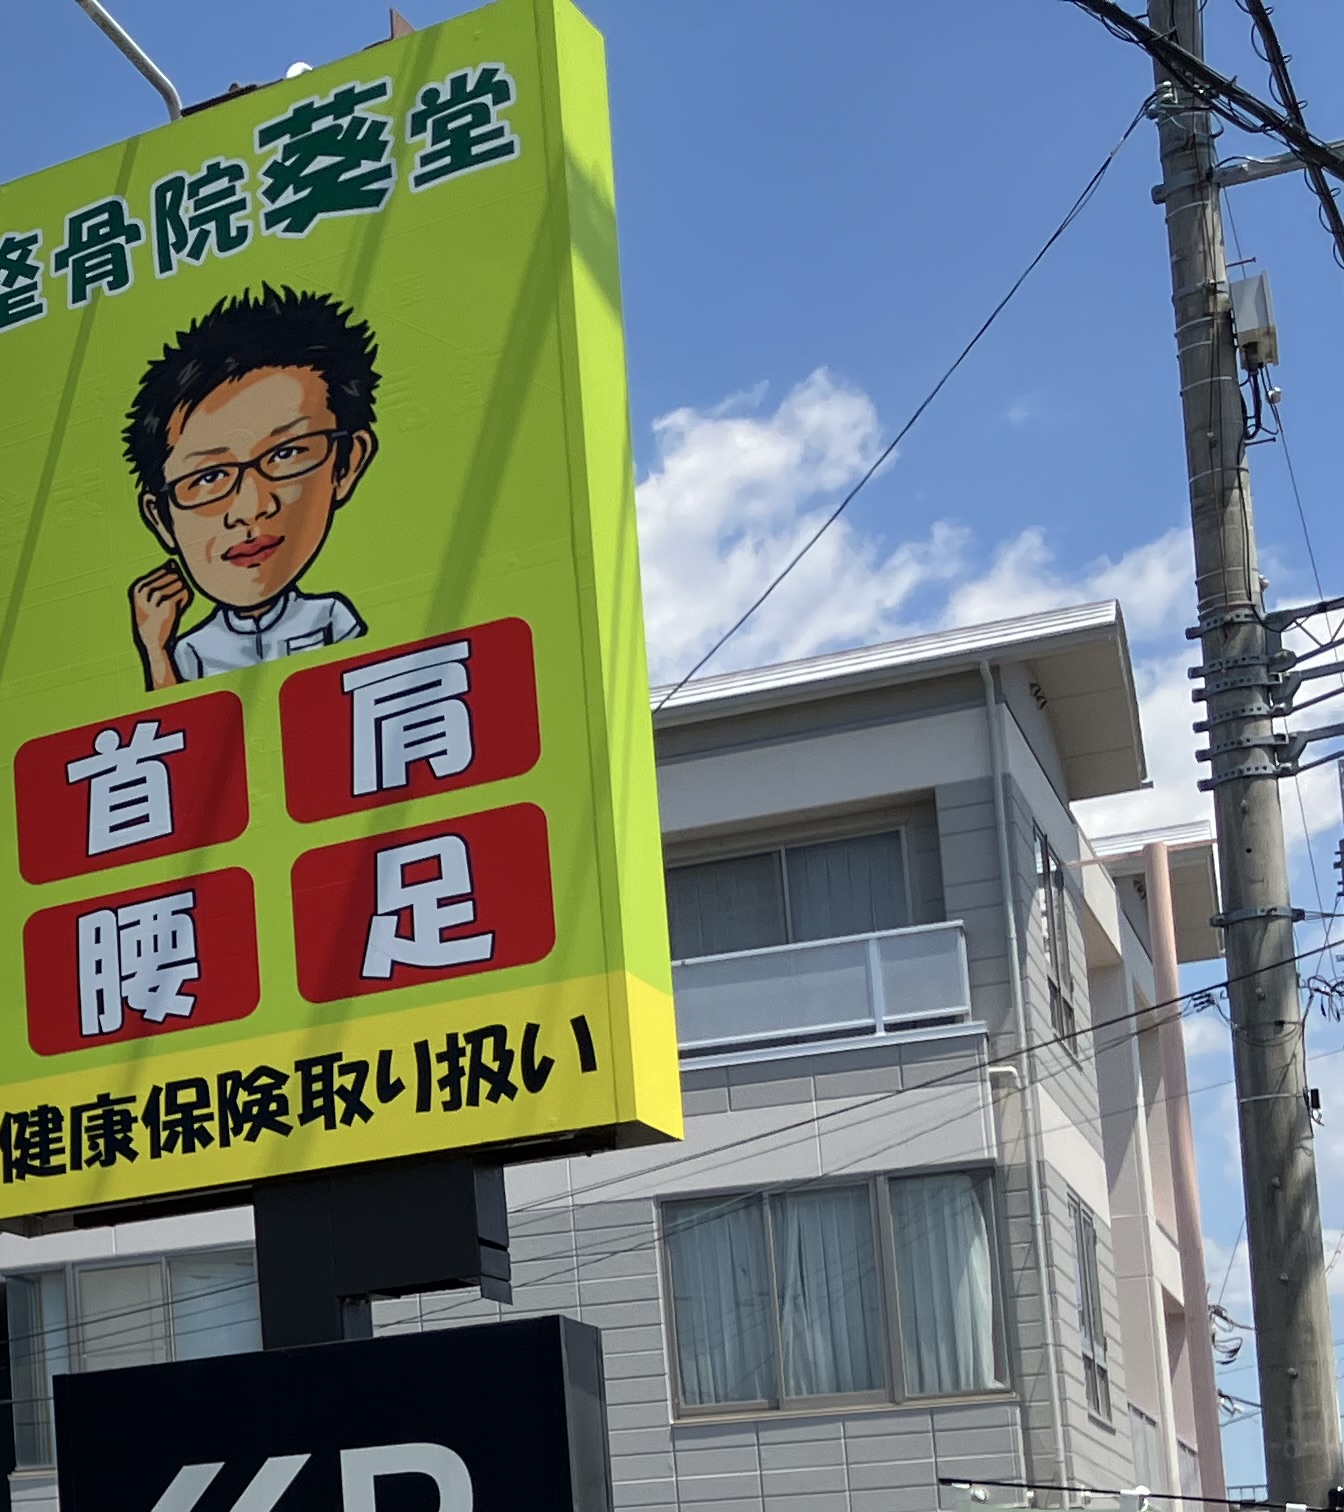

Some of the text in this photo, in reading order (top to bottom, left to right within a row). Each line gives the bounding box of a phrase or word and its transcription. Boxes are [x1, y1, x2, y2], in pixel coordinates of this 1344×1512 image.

[65, 719, 186, 857] 首
[340, 641, 473, 797] 肩
[77, 889, 201, 1037] 腰
[360, 833, 495, 979] 足
